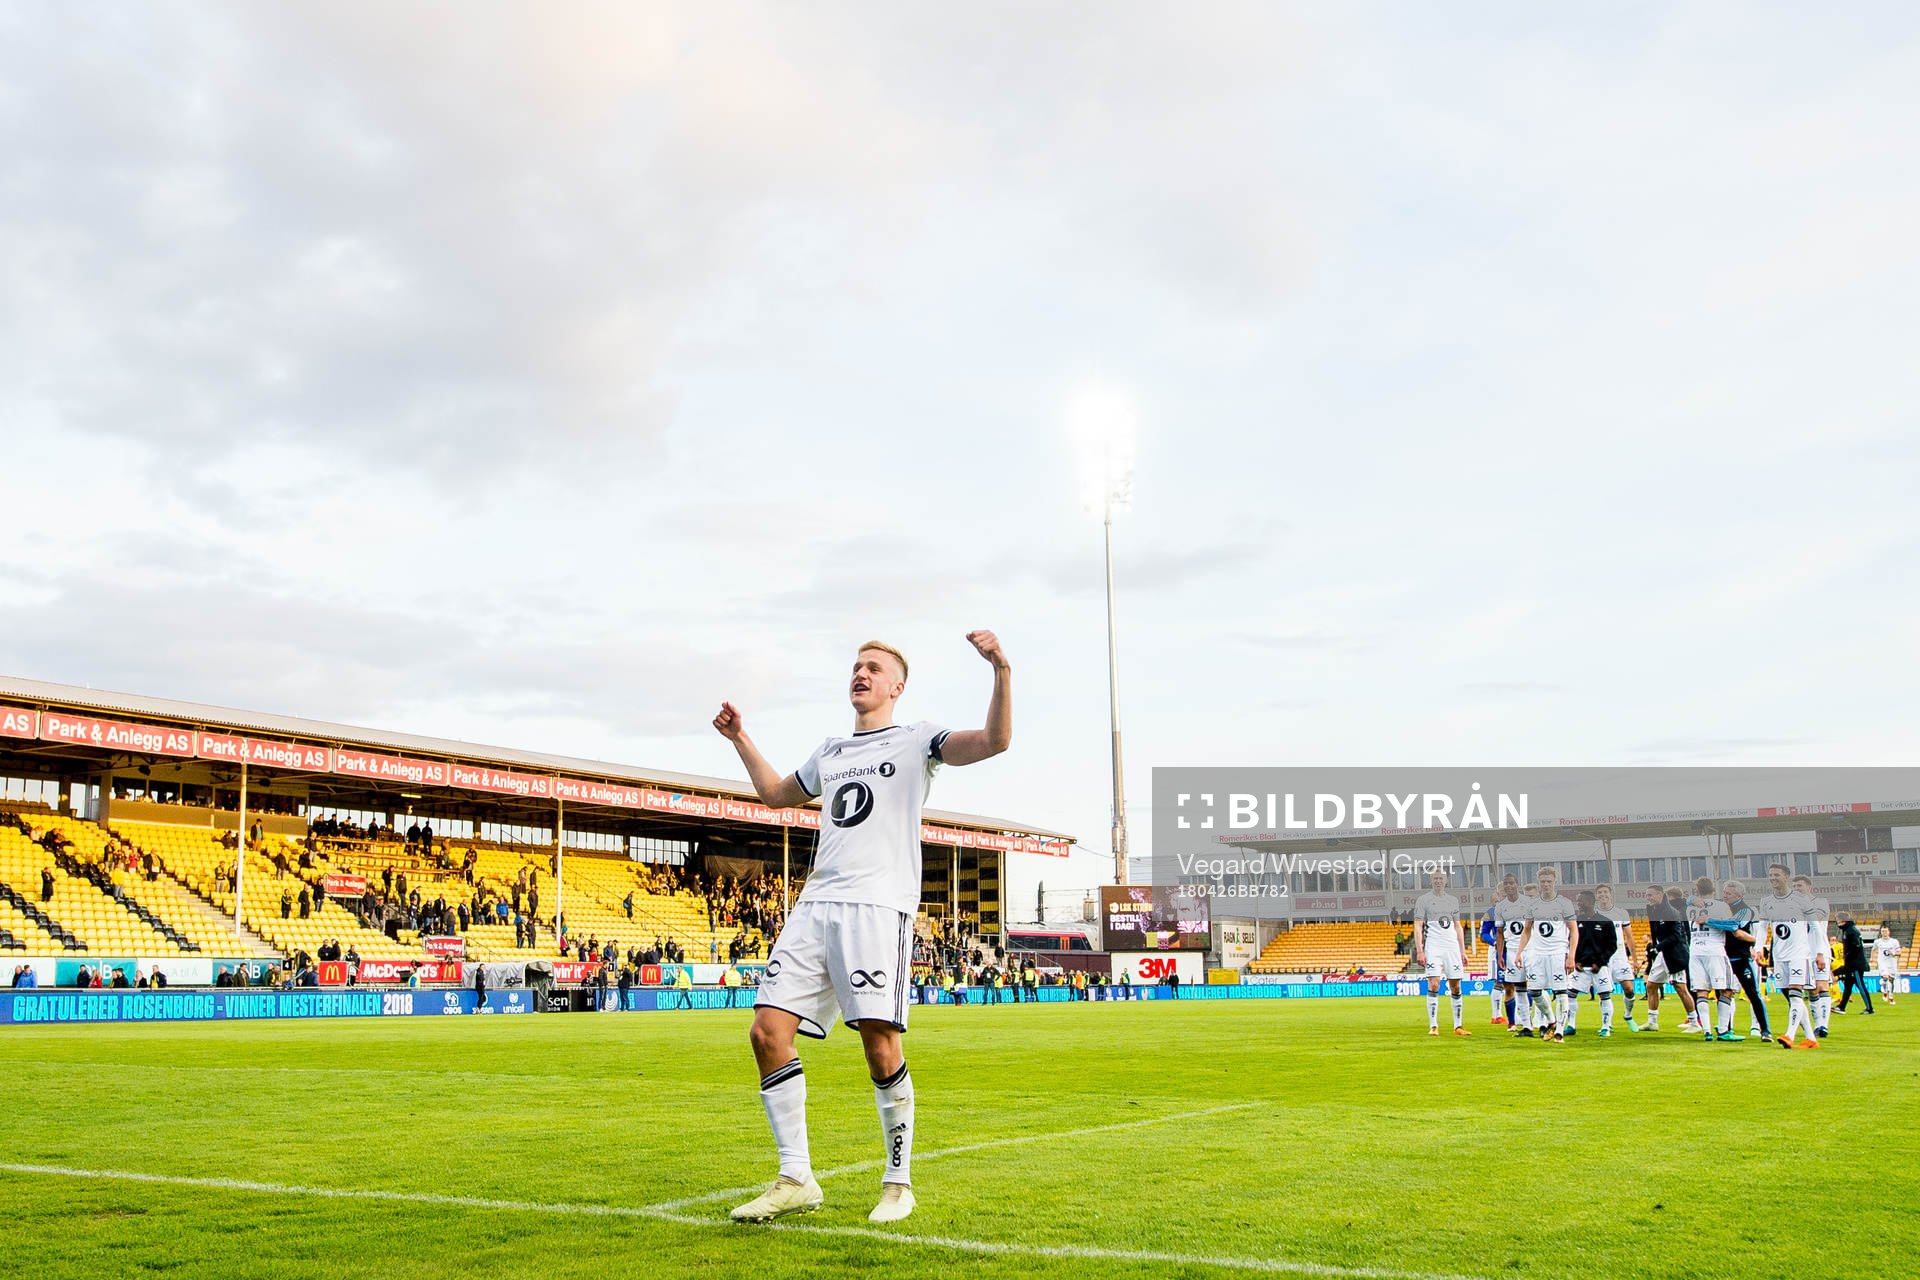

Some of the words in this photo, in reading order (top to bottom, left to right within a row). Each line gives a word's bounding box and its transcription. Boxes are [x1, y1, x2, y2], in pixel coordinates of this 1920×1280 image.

[3, 713, 29, 732] AS
[48, 719, 87, 739] Park
[91, 723, 102, 743] &
[106, 726, 162, 751] Anlegg
[166, 734, 188, 751] AS
[203, 737, 236, 755] Park
[240, 741, 250, 758] &
[253, 744, 302, 767] Anlegg
[304, 751, 324, 767] AS
[338, 754, 367, 772] Park
[370, 758, 378, 773] &
[381, 760, 423, 782] Anlegg
[425, 766, 443, 781] AS
[823, 765, 877, 784] SpareBank
[454, 769, 480, 785] Park
[482, 772, 490, 787] &
[492, 774, 529, 794] Anlegg
[531, 780, 546, 793] AS
[556, 782, 578, 796] Park
[581, 785, 588, 798] &
[590, 787, 623, 804] Anlegg
[624, 792, 638, 803] AS
[647, 794, 667, 807] Park
[707, 803, 720, 814] AS
[1776, 804, 1852, 816] RB-TRIBUNEN
[727, 804, 745, 816] Park
[754, 808, 780, 824] Anlegg
[782, 811, 792, 822] AS
[800, 813, 816, 824] Park
[1560, 816, 1606, 825] Romerikes
[1608, 815, 1629, 823] Blad
[924, 828, 937, 838] Park
[964, 834, 972, 843] AS
[1894, 883, 1920, 893] rb.n
[1311, 898, 1336, 909] rb.no
[1358, 898, 1383, 907] rb.no
[1138, 958, 1177, 979] 3M
[1174, 986, 1224, 1000] RATULERER
[13, 995, 118, 1021] GRATULERER
[123, 994, 215, 1020] ROSENBORG
[225, 994, 275, 1018] VINNER
[279, 993, 381, 1017] MESTERFINALEN
[383, 993, 413, 1015] 2018
